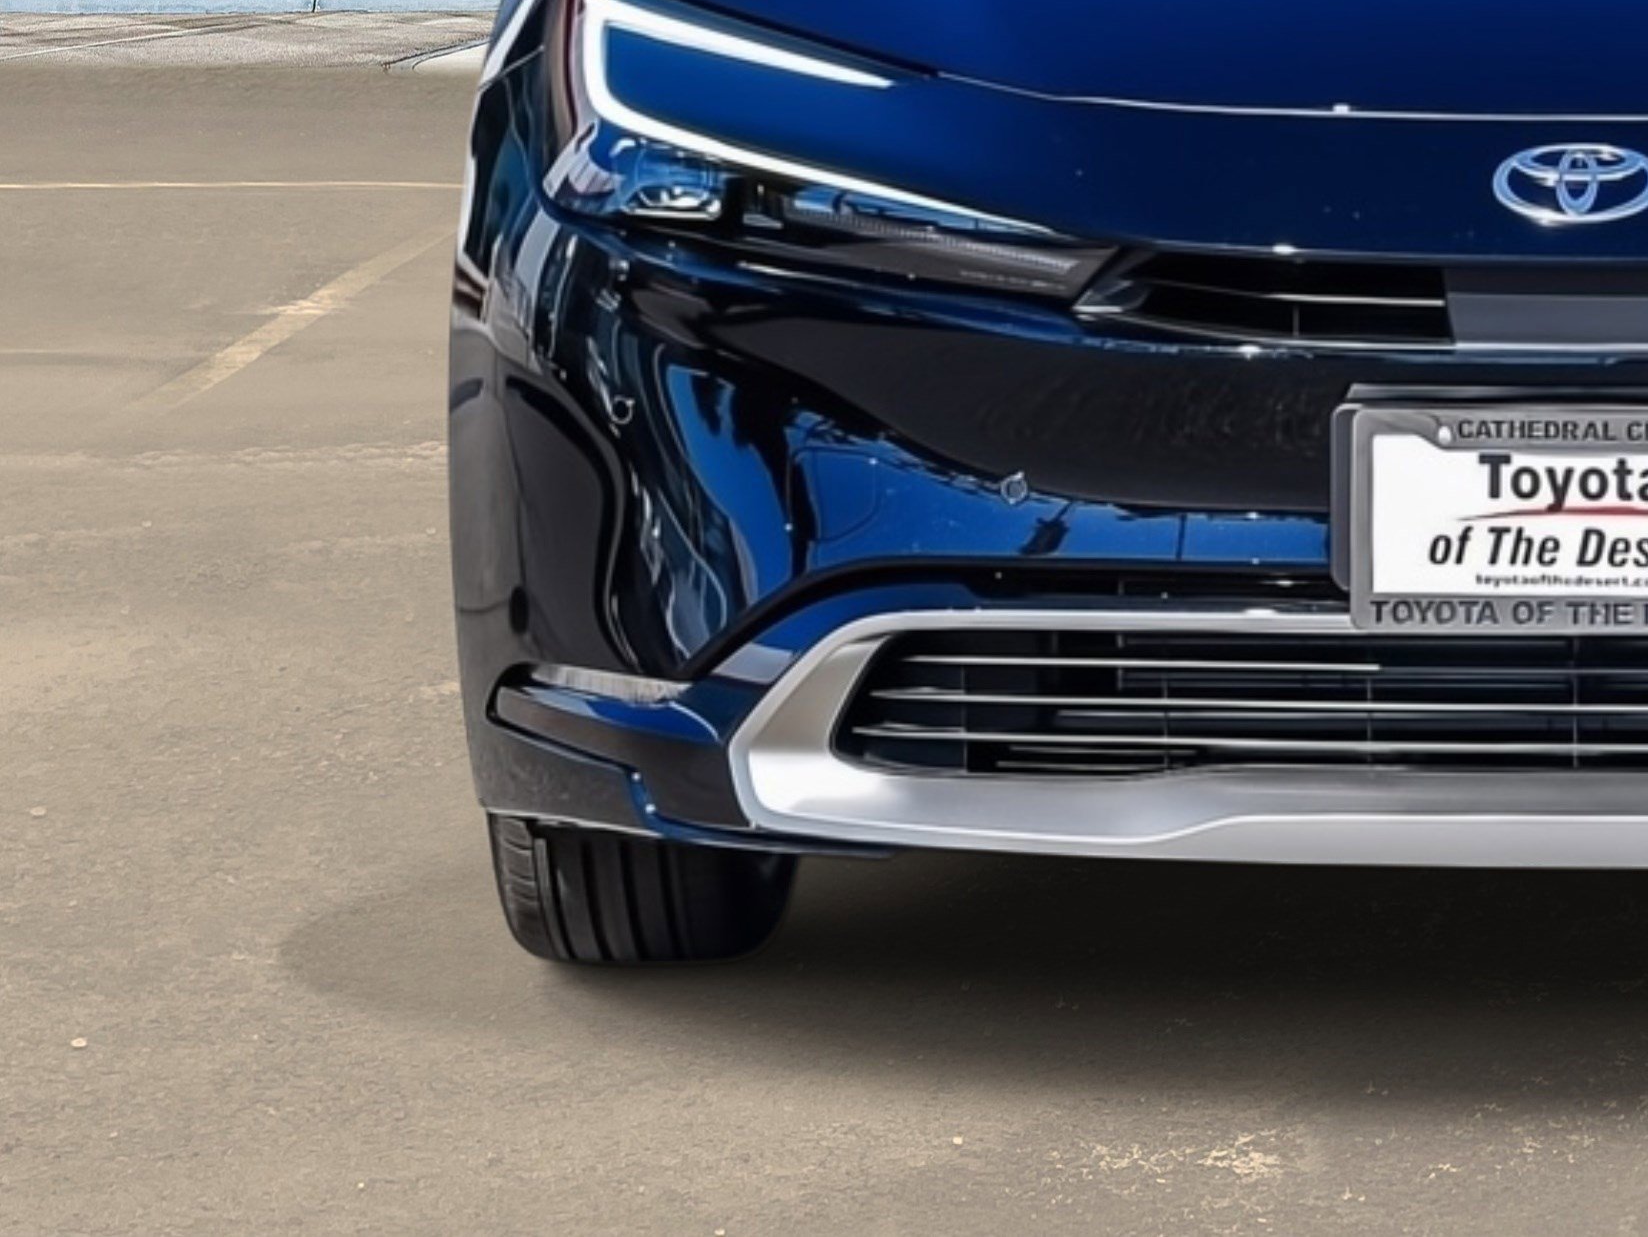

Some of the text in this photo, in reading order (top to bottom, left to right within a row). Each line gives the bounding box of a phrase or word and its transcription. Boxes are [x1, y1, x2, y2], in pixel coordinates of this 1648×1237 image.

[1457, 419, 1616, 442] CATHEDRAL
[1429, 526, 1473, 566] of
[1487, 526, 1561, 566] The
[1371, 599, 1498, 625] TOYOTA
[1512, 600, 1553, 625] OF
[1566, 601, 1638, 626] THE
